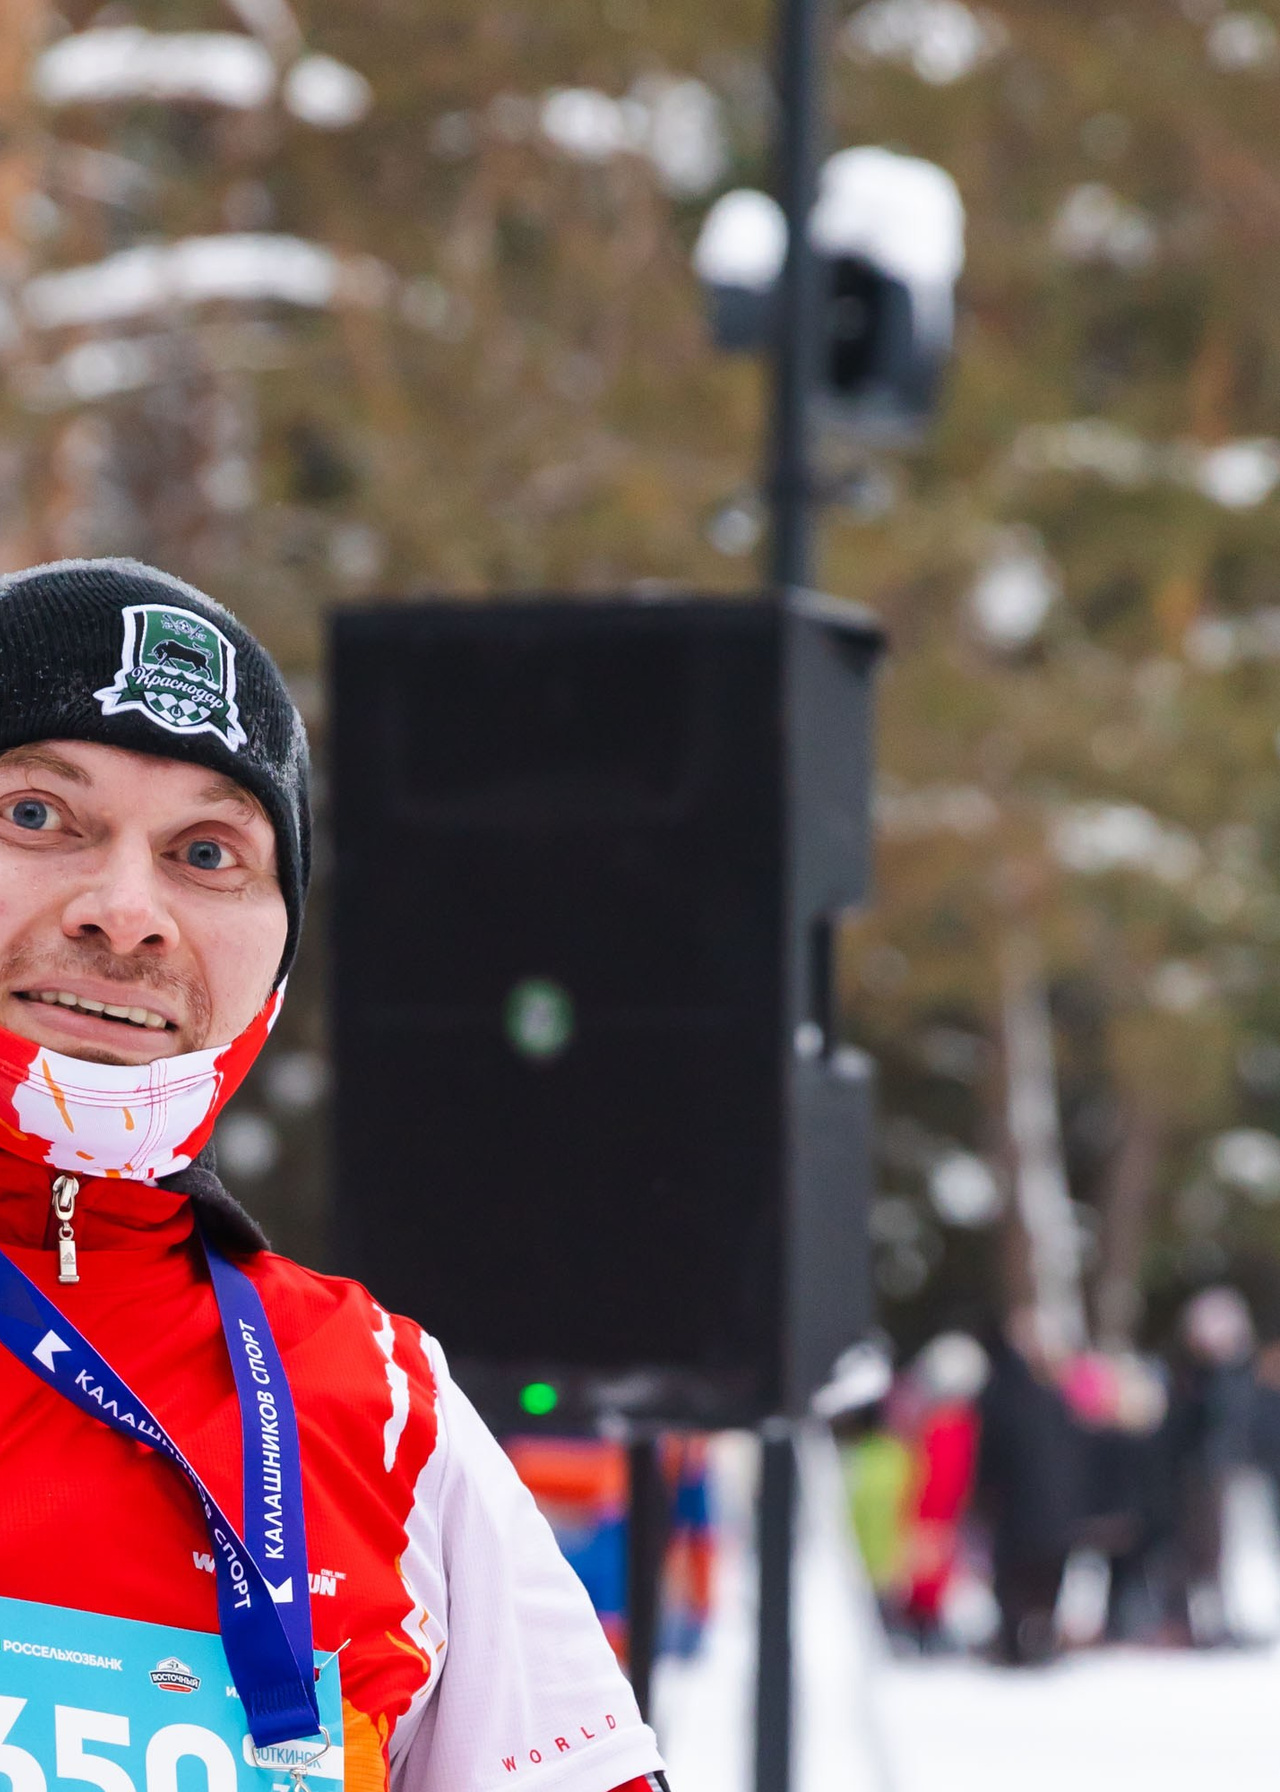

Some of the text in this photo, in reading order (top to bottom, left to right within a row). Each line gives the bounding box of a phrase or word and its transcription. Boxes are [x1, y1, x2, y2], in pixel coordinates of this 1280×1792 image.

[132, 666, 224, 709] Краснодар
[239, 1319, 285, 1560] КАЛАШНИКОВ СПОРТ
[214, 1528, 252, 1610] СПОРТ
[308, 1574, 337, 1597] UN
[3, 1639, 123, 1671] РОССЕЛЬХОЗБАНК
[152, 1673, 198, 1688] ВОСТОЧНЫЙ
[502, 1714, 617, 1773] WORLD
